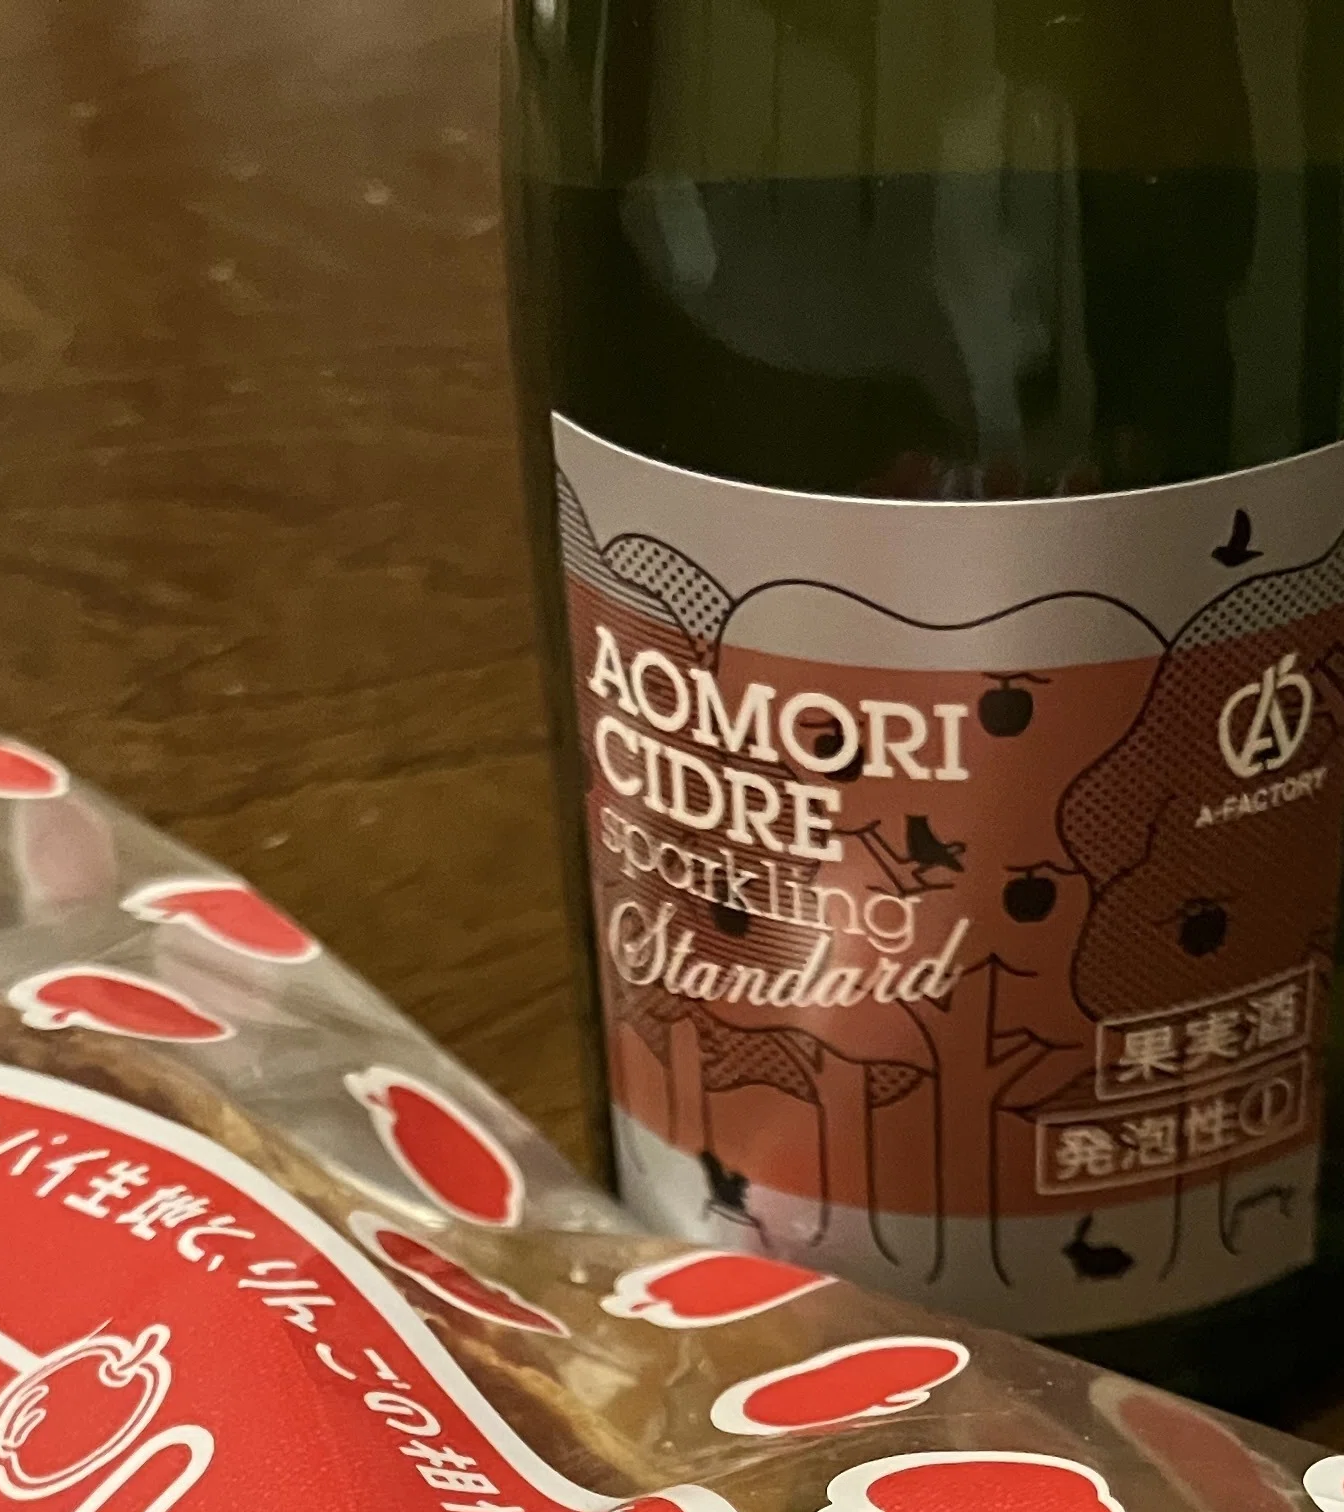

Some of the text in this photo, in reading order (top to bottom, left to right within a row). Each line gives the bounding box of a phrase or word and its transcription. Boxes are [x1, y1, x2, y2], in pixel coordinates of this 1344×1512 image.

[589, 625, 969, 781] AOMORI
[594, 715, 844, 862] CIDRE
[1194, 767, 1328, 828] A-FACTORY
[601, 807, 922, 953] sparkling
[608, 901, 969, 1008] Standard
[1117, 983, 1299, 1082] 果実酒
